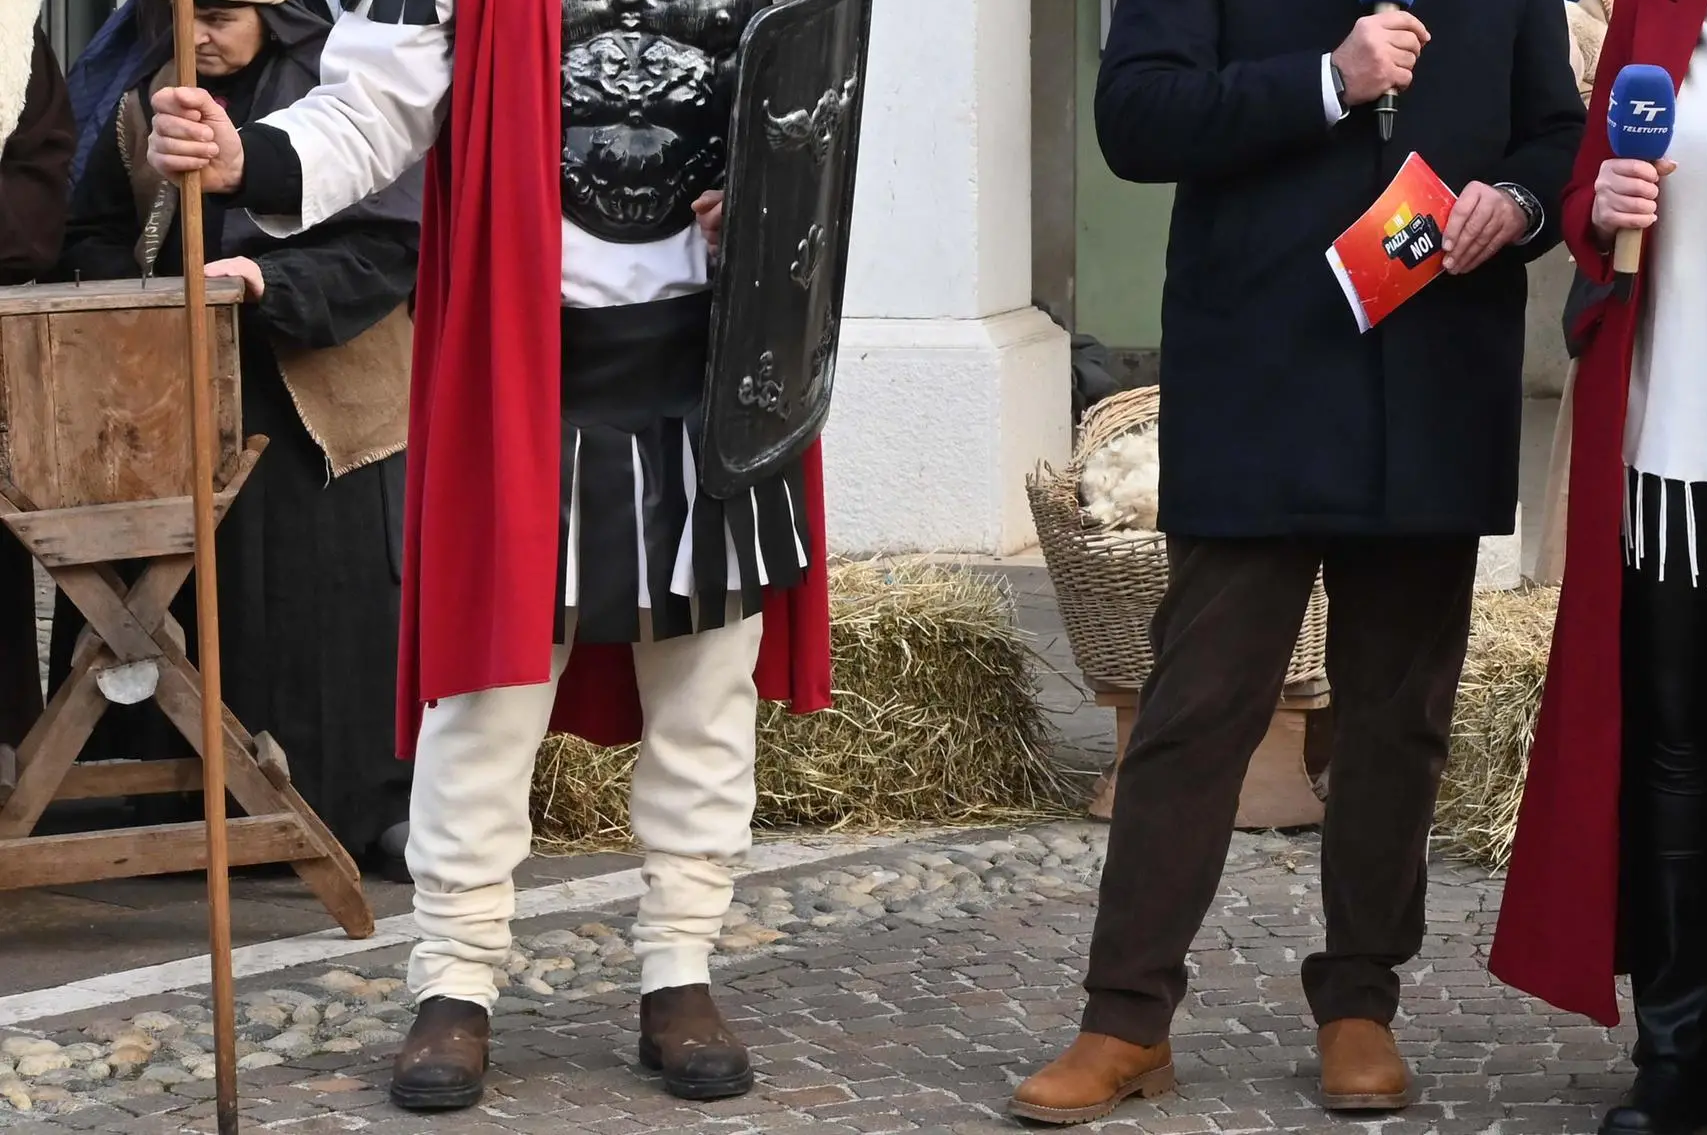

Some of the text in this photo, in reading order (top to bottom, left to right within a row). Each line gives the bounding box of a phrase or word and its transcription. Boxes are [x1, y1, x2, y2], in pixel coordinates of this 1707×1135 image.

[1622, 125, 1669, 134] TELETUTTO
[1384, 229, 1410, 255] PIAZZA
[1409, 232, 1434, 261] NOI
